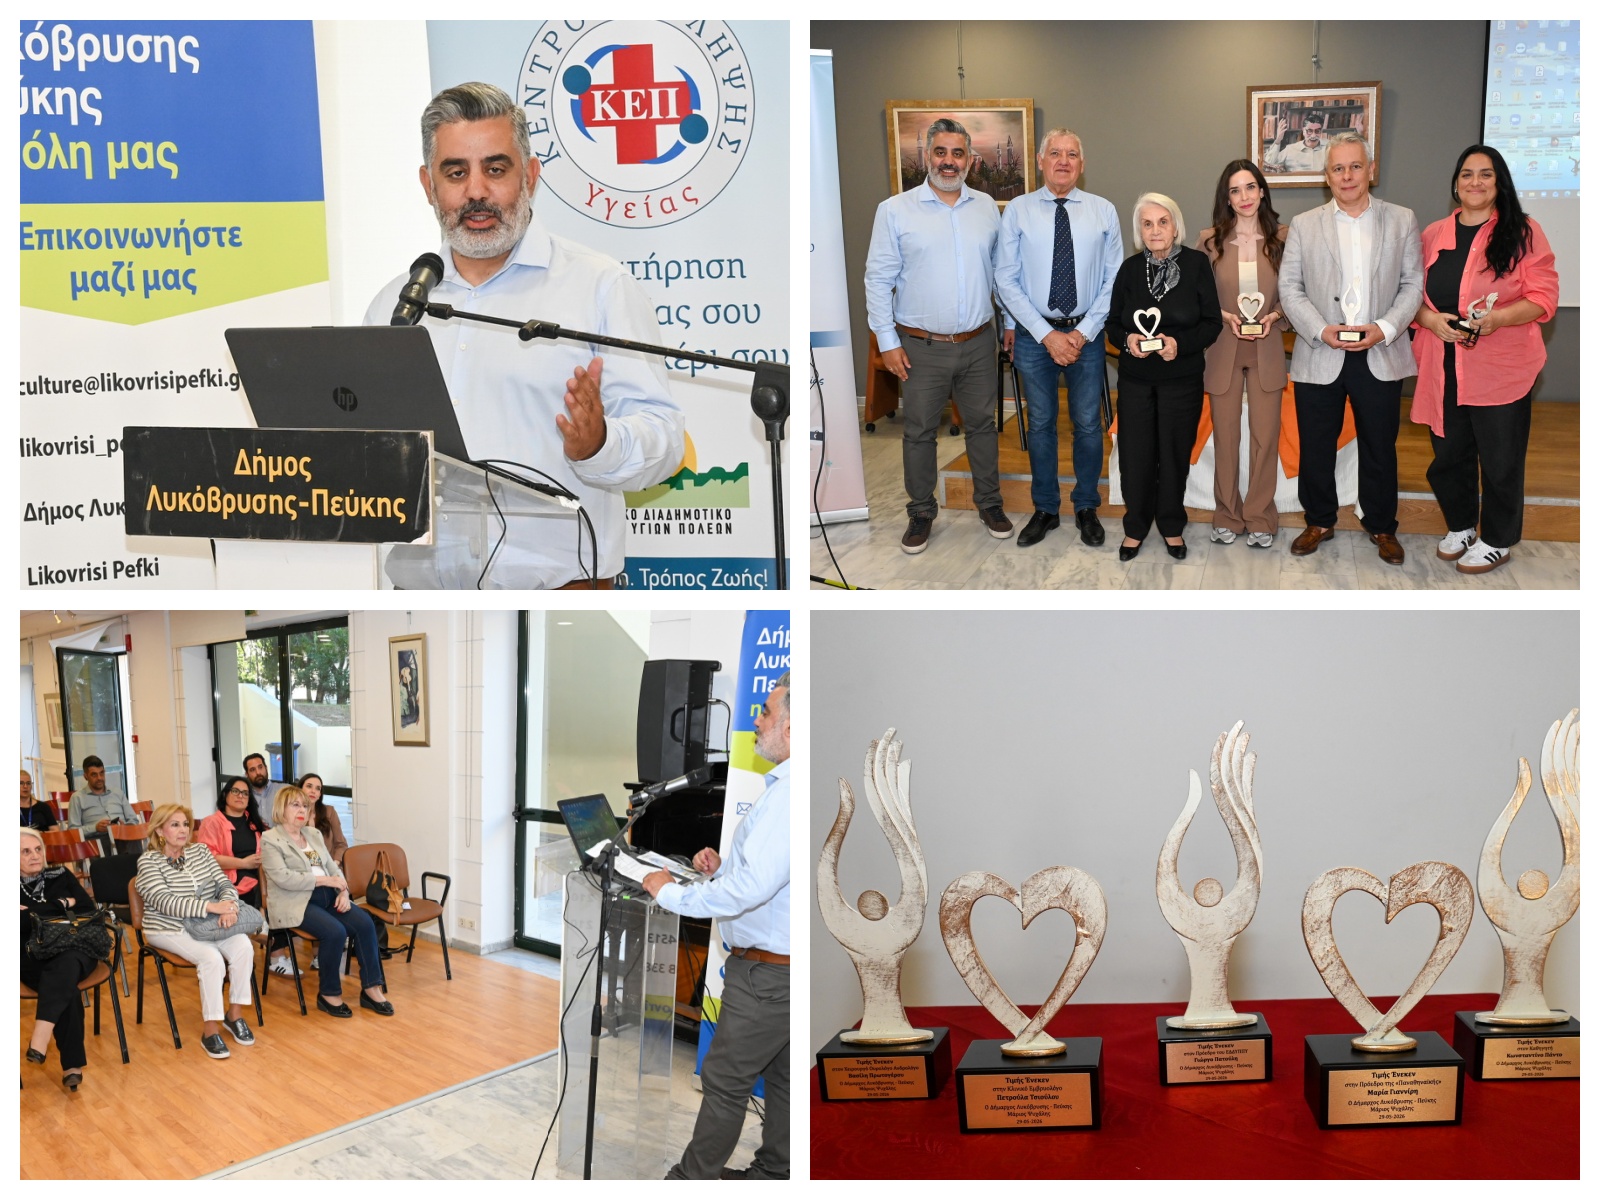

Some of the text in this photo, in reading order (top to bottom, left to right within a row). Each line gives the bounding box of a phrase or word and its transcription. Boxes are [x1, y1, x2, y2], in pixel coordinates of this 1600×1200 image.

[590, 88, 682, 122] ΚΕΠ
[22, 129, 178, 180] όλη μας
[585, 182, 699, 220] Υγείας
[20, 218, 243, 256] Επικοινωνήστε
[70, 261, 198, 300] μαζί μας
[621, 252, 746, 288] τήρηση
[702, 303, 761, 324] σου
[234, 448, 312, 482] Δήμος
[24, 499, 125, 525] Δήμος Λυκ
[146, 484, 406, 524] Λυκόβρυσης-Πεύκης
[644, 508, 732, 520] ΔΙΑΔΗΜΟΤΙΚΟ
[631, 522, 733, 535] ΥΓΙΩΝ ΠΟΛΕΩΝ
[28, 557, 159, 586] Likovrisi Pefki
[639, 568, 706, 590] Τρόπος
[711, 568, 768, 590] Ζωής!
[754, 652, 790, 669] Λυκ
